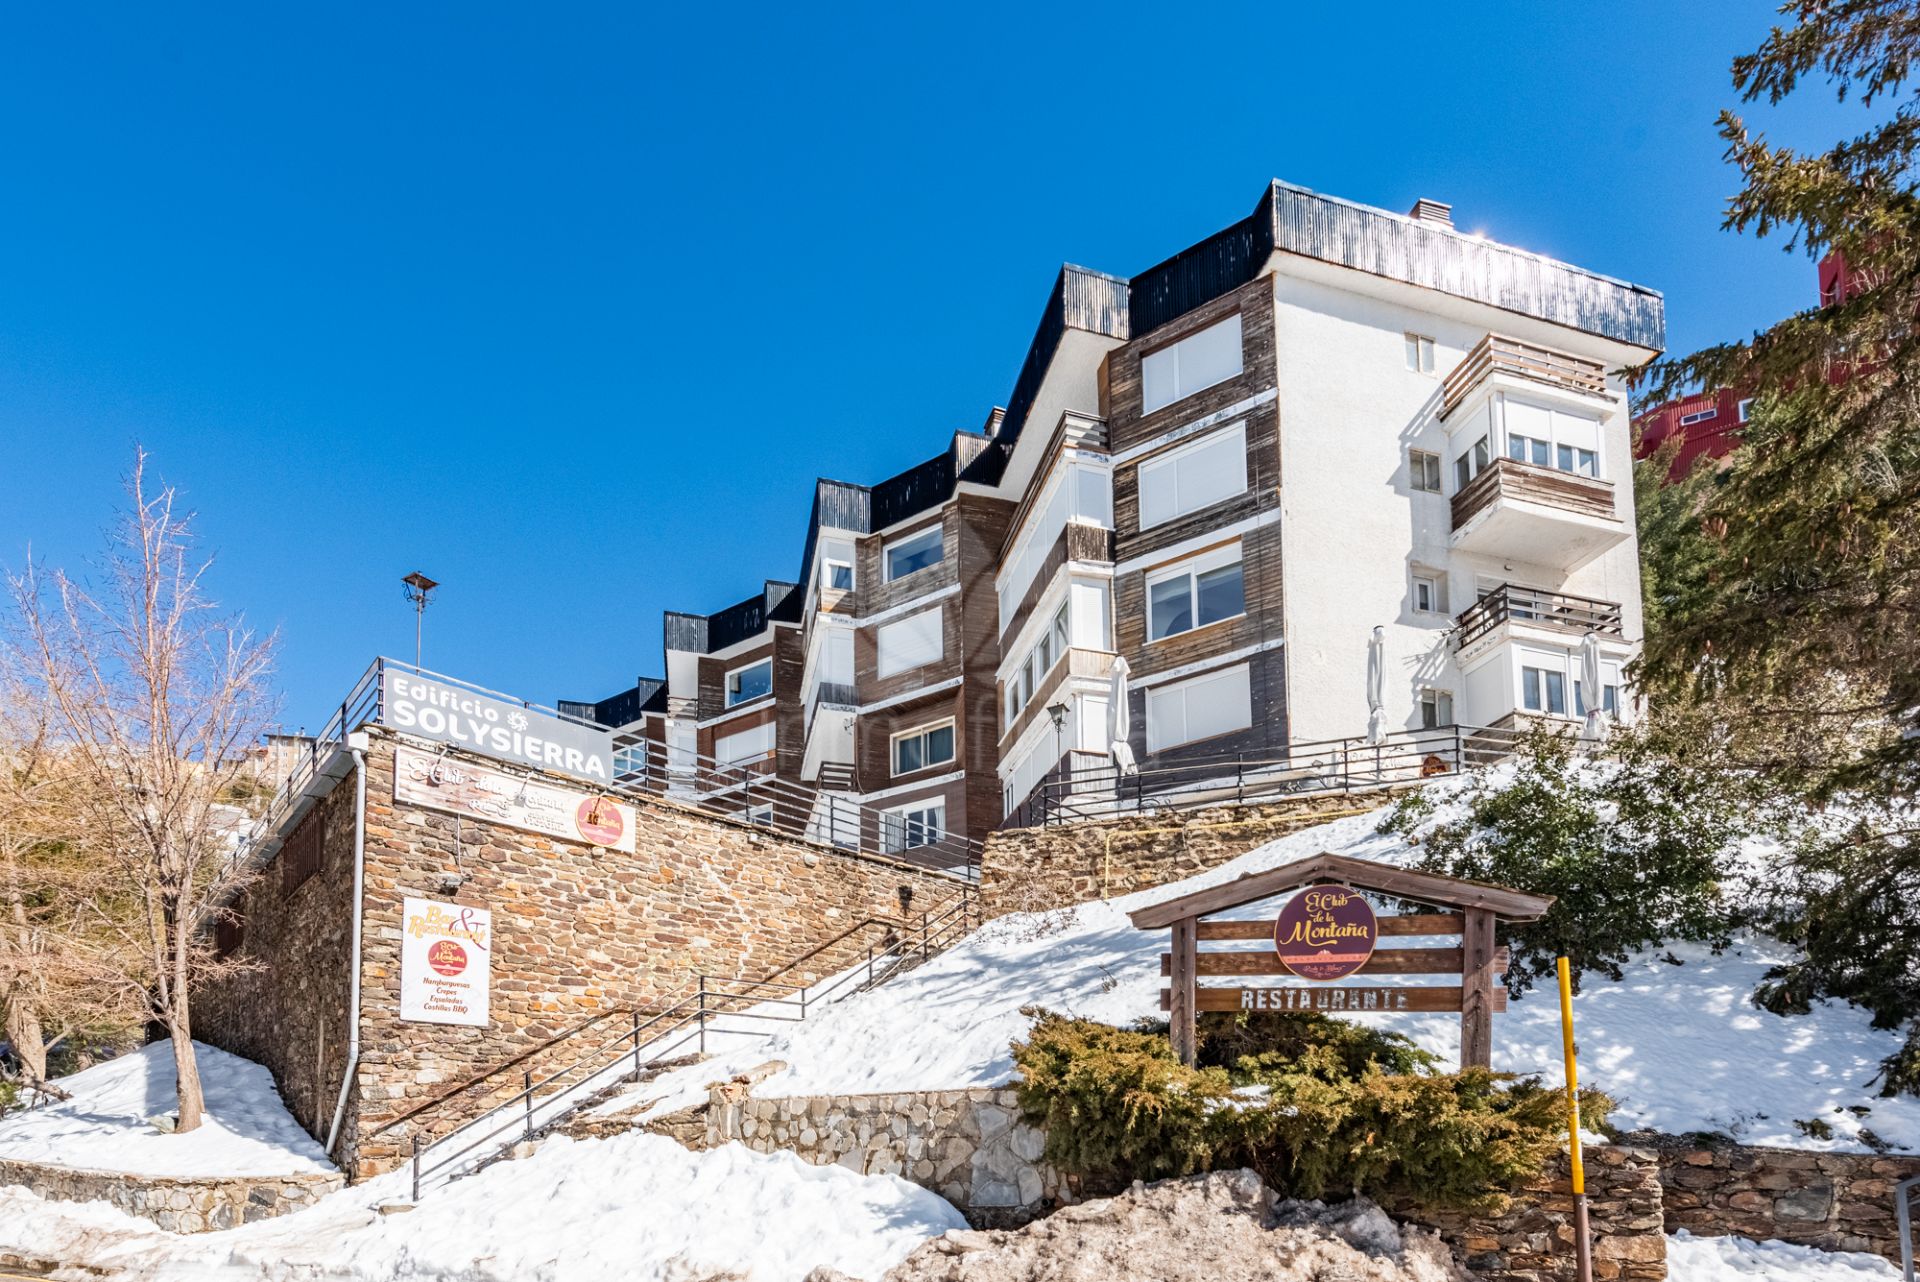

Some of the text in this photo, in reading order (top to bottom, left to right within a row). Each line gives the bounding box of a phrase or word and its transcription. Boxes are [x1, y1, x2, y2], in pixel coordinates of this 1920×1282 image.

[393, 677, 499, 722] Edificio
[393, 699, 606, 779] SOLYSIERRA
[1305, 892, 1357, 913] El Club
[425, 906, 456, 924] Bar
[1310, 911, 1335, 923] de la
[1279, 920, 1369, 947] Montaña
[1241, 989, 1408, 1009] RESTAURANTE
